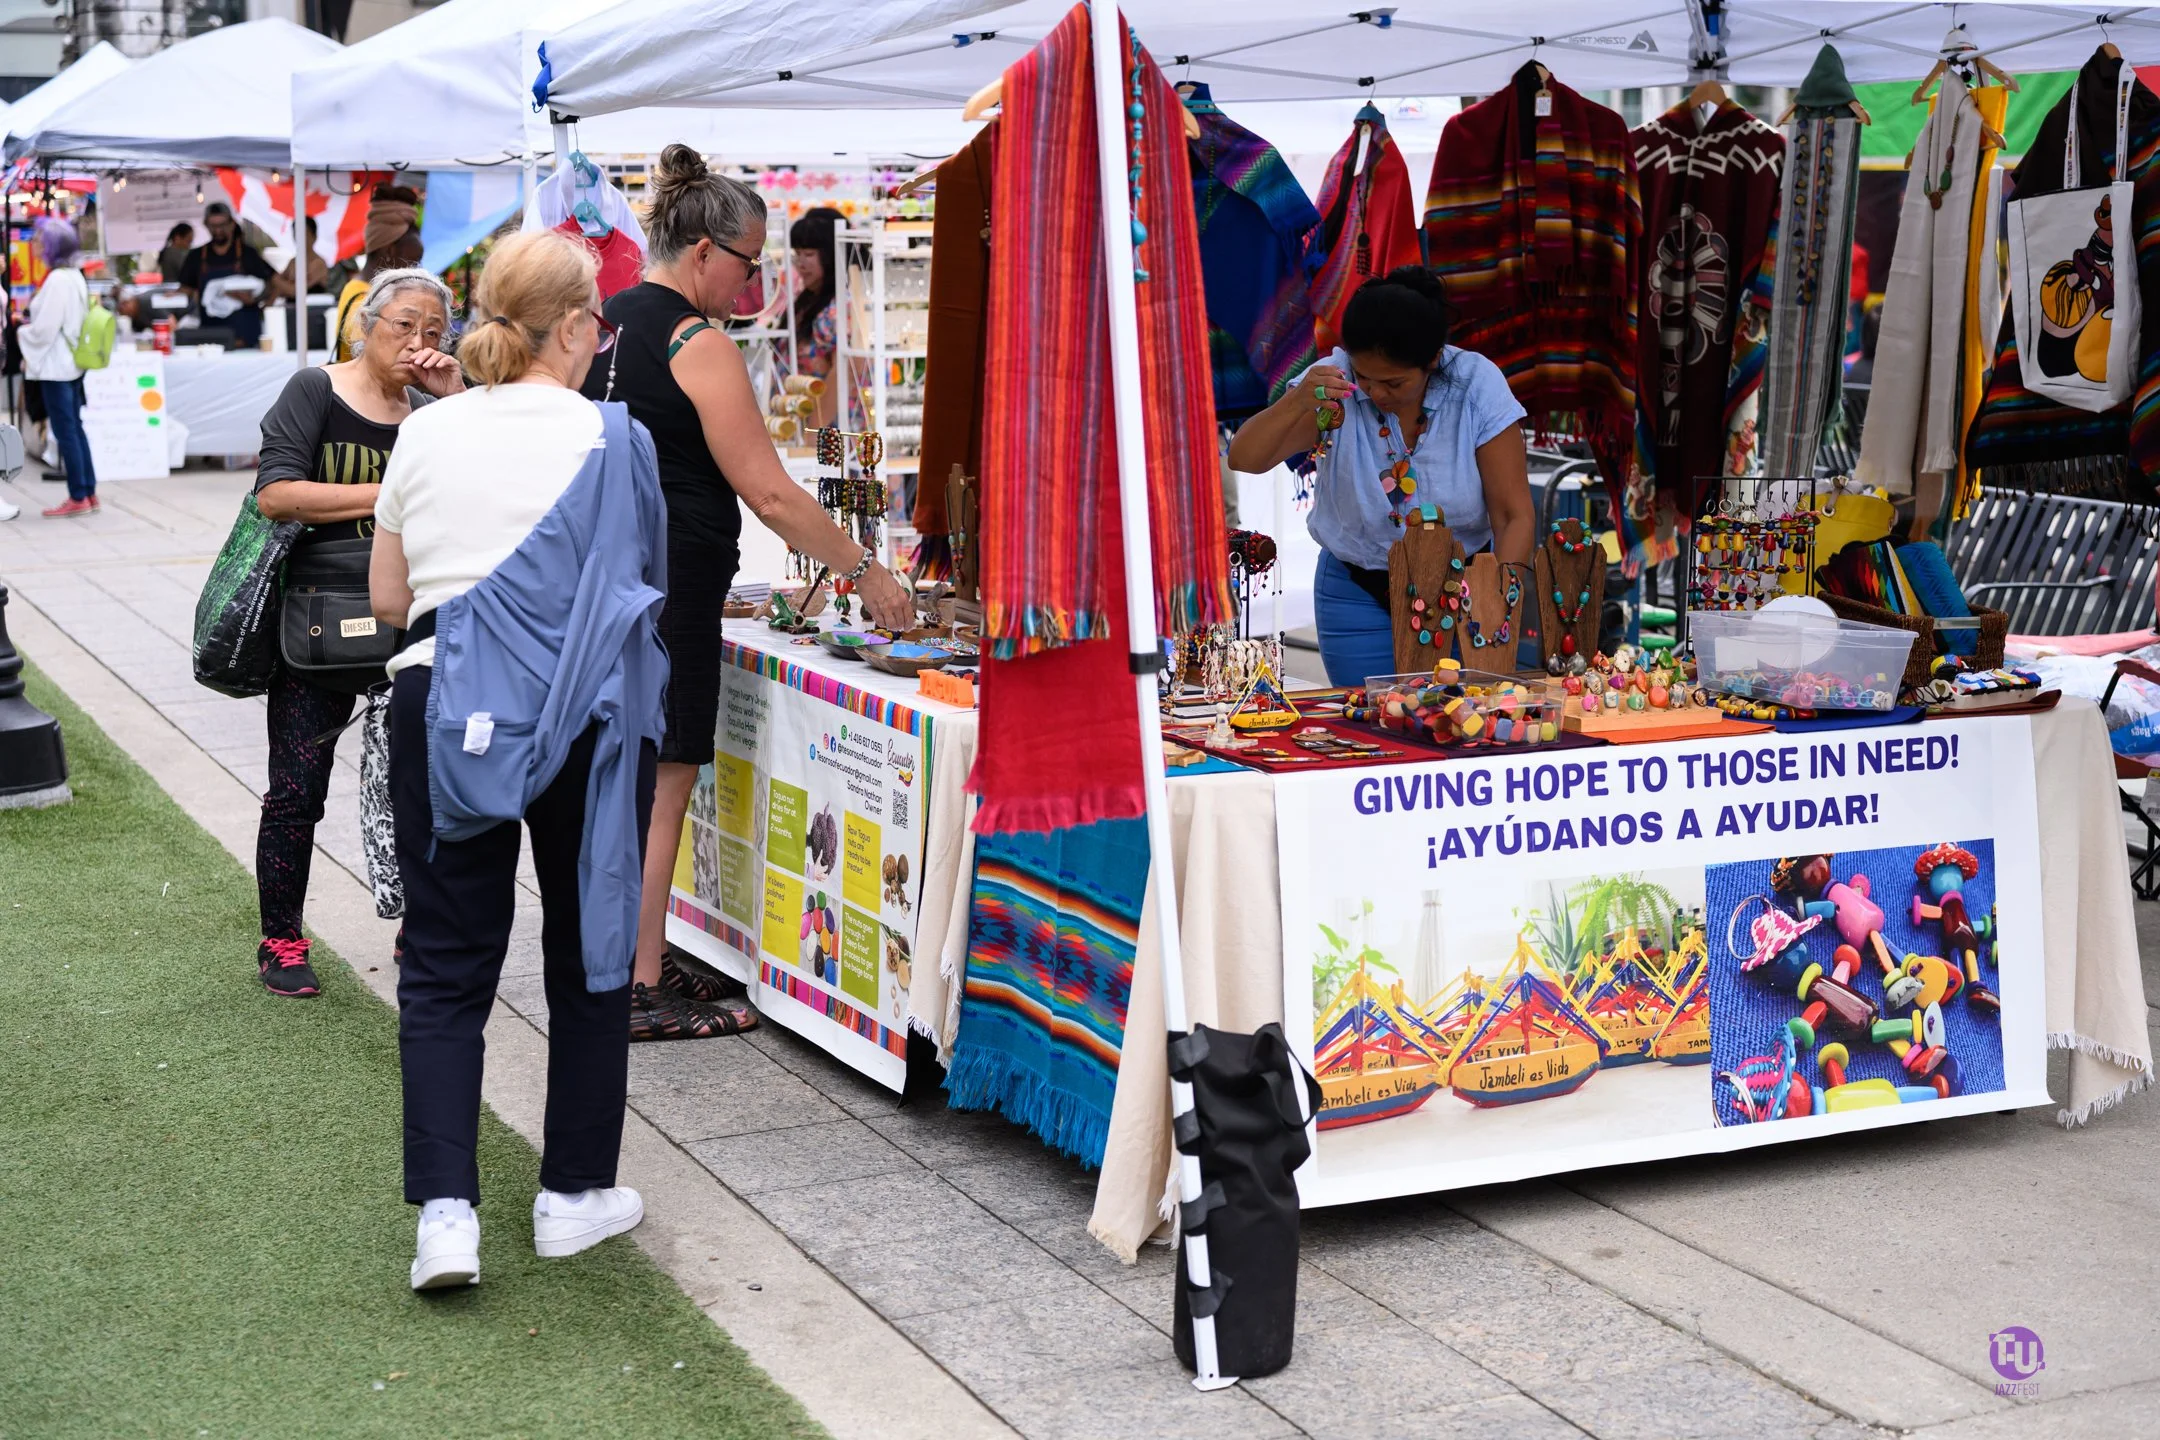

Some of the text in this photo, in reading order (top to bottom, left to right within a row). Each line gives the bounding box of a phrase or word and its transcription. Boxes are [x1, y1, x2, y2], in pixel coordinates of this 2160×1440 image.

[246, 576, 267, 616] Environment
[242, 615, 251, 627] the
[343, 621, 373, 634] DIESEL
[239, 627, 247, 637] of
[232, 636, 245, 659] Friends
[228, 659, 237, 669] TD
[1353, 734, 1959, 815] GIVING HOPE TO THOSE IN NEED!
[847, 780, 883, 804] Sandra Nathan
[865, 800, 883, 815] Owner
[770, 823, 774, 832] 2
[1427, 793, 1880, 869] ¡AYÚDANOS A AYUDAR!
[1687, 1038, 1712, 1049] JAM
[1480, 1063, 1525, 1090] Jambeli
[1547, 1055, 1569, 1078] Vida
[1320, 1077, 1417, 1109] ambeli es Vida
